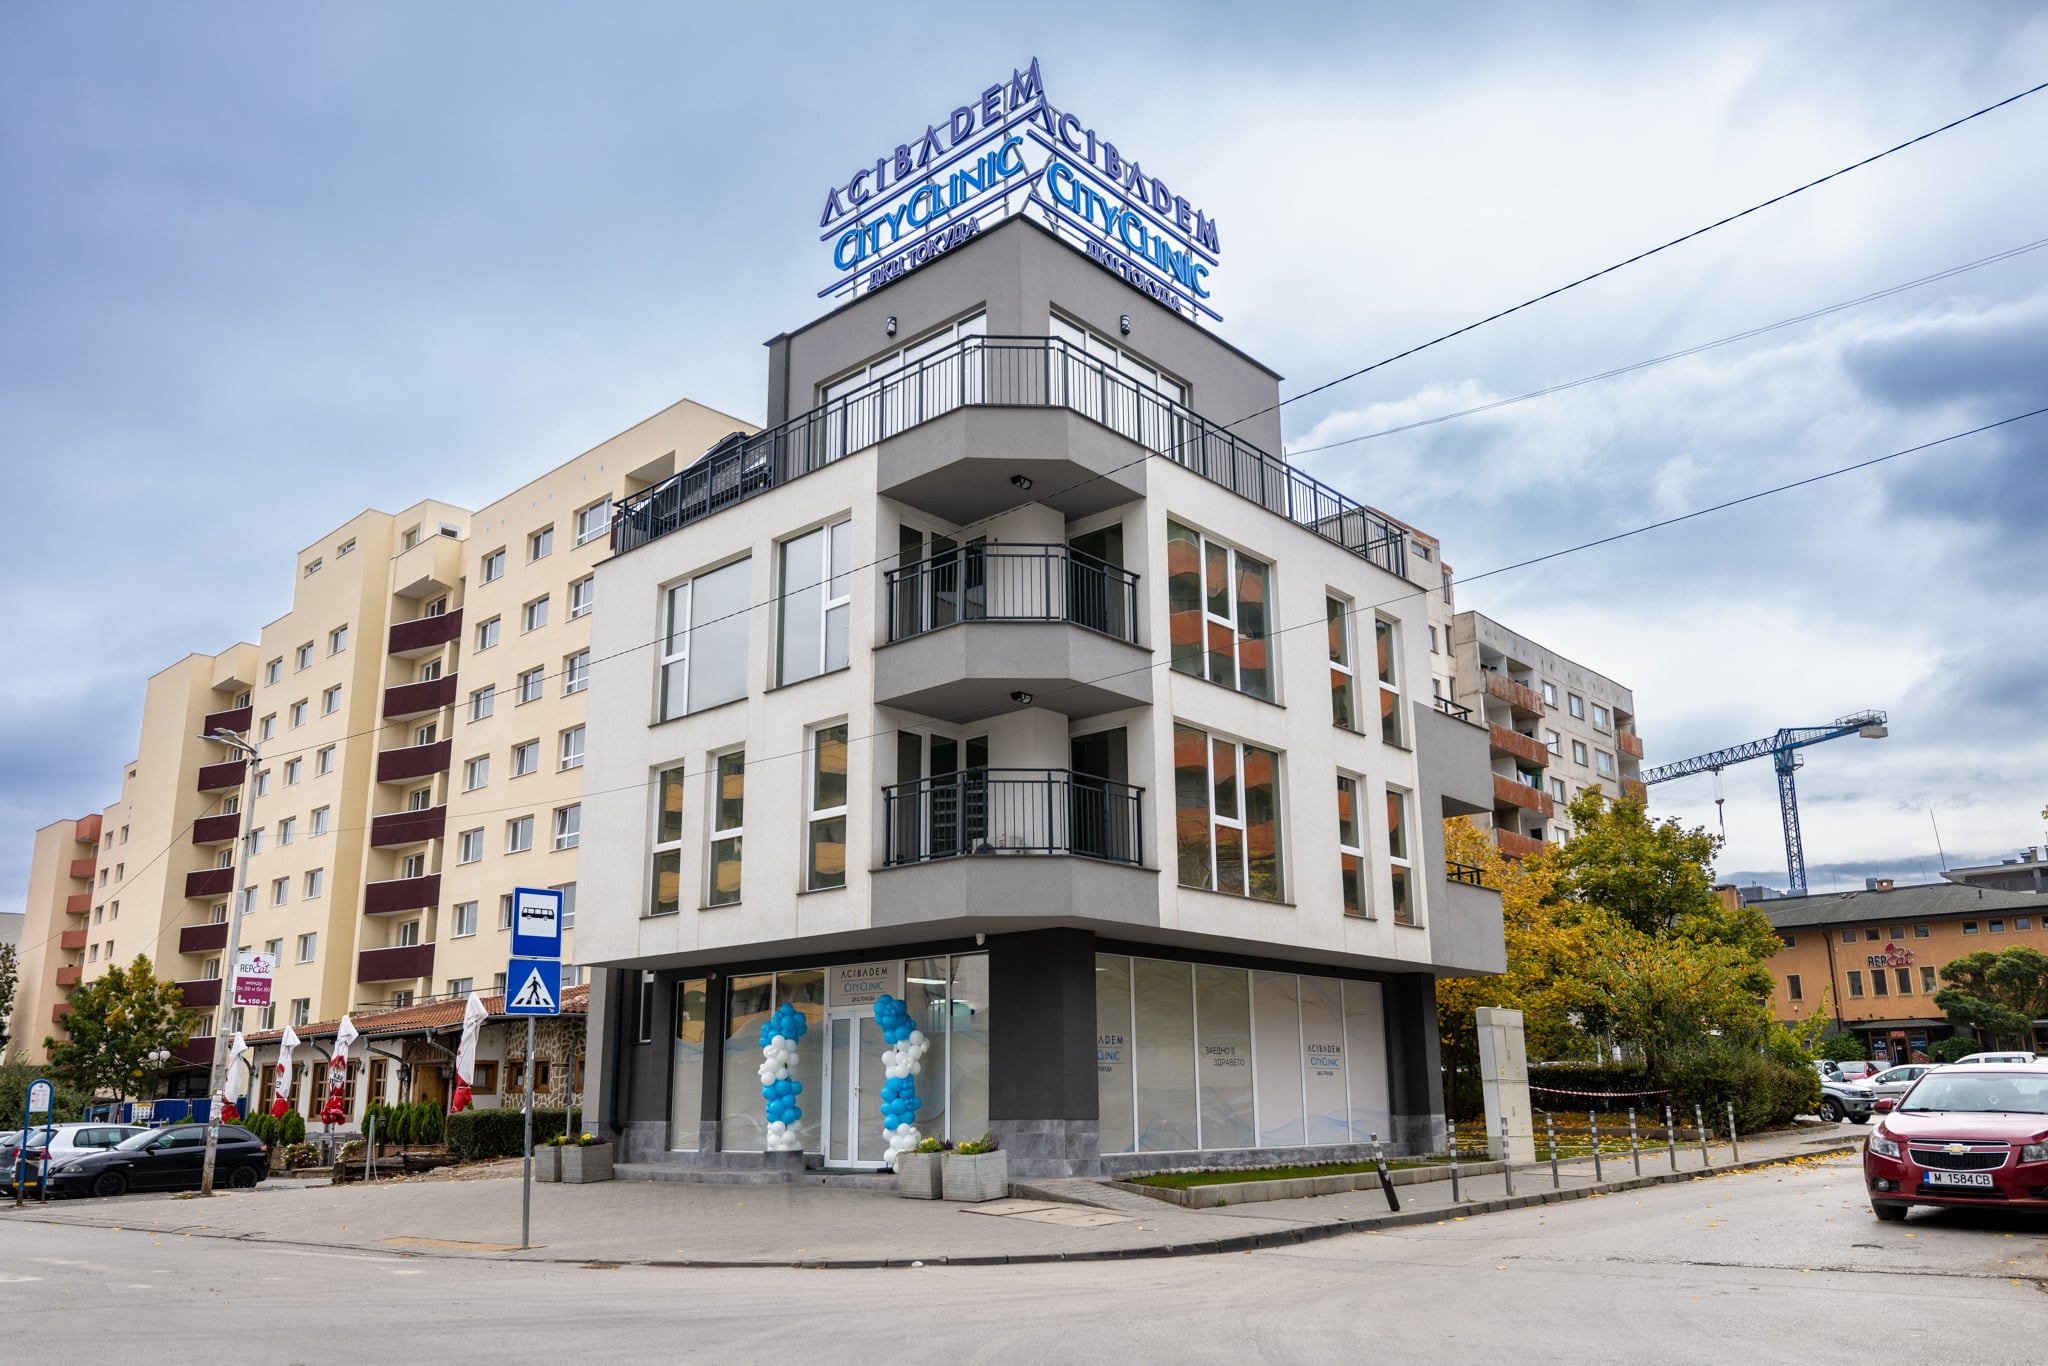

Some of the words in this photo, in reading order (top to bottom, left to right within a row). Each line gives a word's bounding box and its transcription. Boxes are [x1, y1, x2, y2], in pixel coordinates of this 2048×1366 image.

[820, 56, 1044, 227] ACIBADEM
[1028, 94, 1220, 254] ACIBADEM
[867, 256, 905, 292] ДКЦ
[907, 217, 981, 268] ТОКУДА
[1086, 240, 1121, 274] ДКЦ
[1120, 262, 1182, 313] ТОКУДА
[841, 967, 888, 979] ACIBADEM
[1205, 1046, 1230, 1055] ЗАЕДНО
[1214, 1057, 1246, 1067] ЗДРАВЕТО
[1307, 1044, 1341, 1053] ACIBADEM
